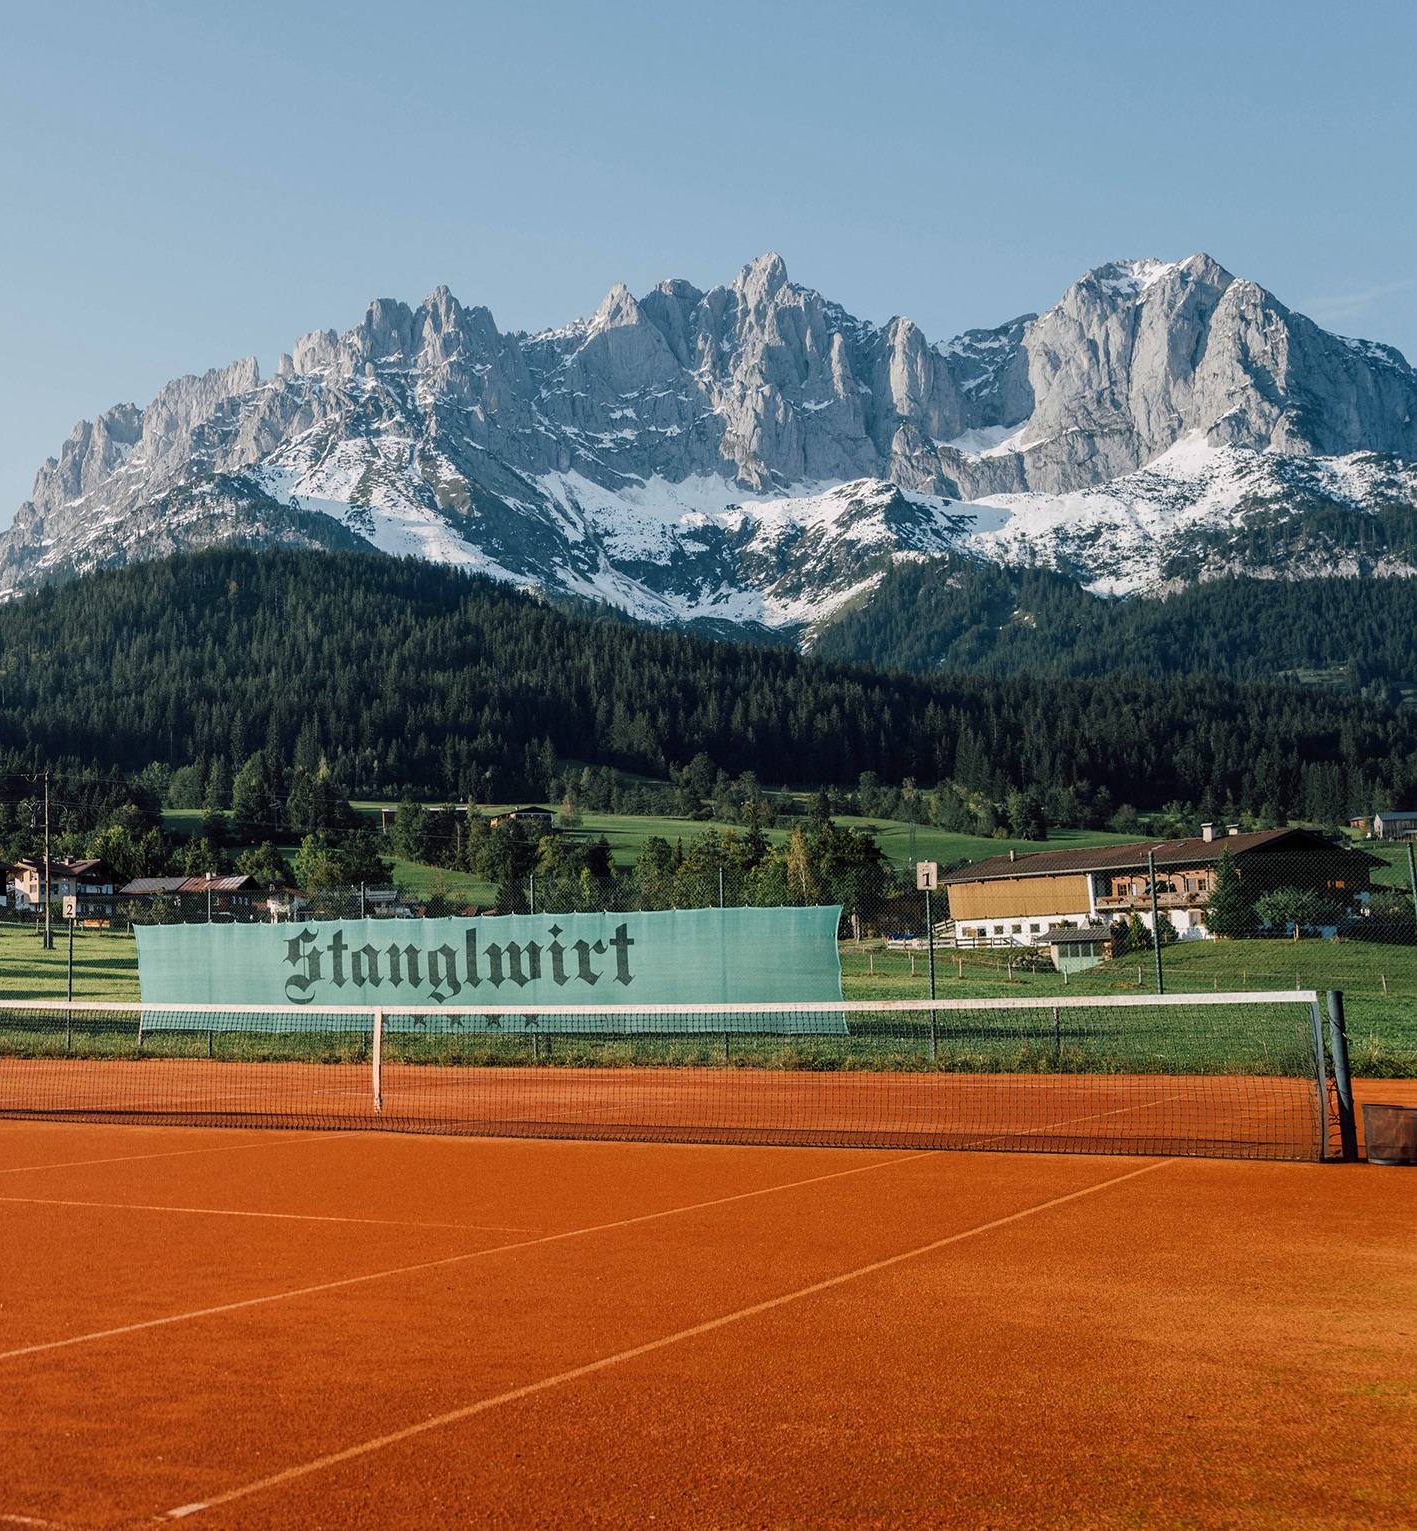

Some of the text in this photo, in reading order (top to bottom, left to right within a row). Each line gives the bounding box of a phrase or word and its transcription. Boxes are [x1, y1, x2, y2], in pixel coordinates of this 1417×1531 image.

[922, 872, 932, 887] 1
[66, 904, 73, 916] 2
[283, 923, 636, 1005] Stanglwirt
